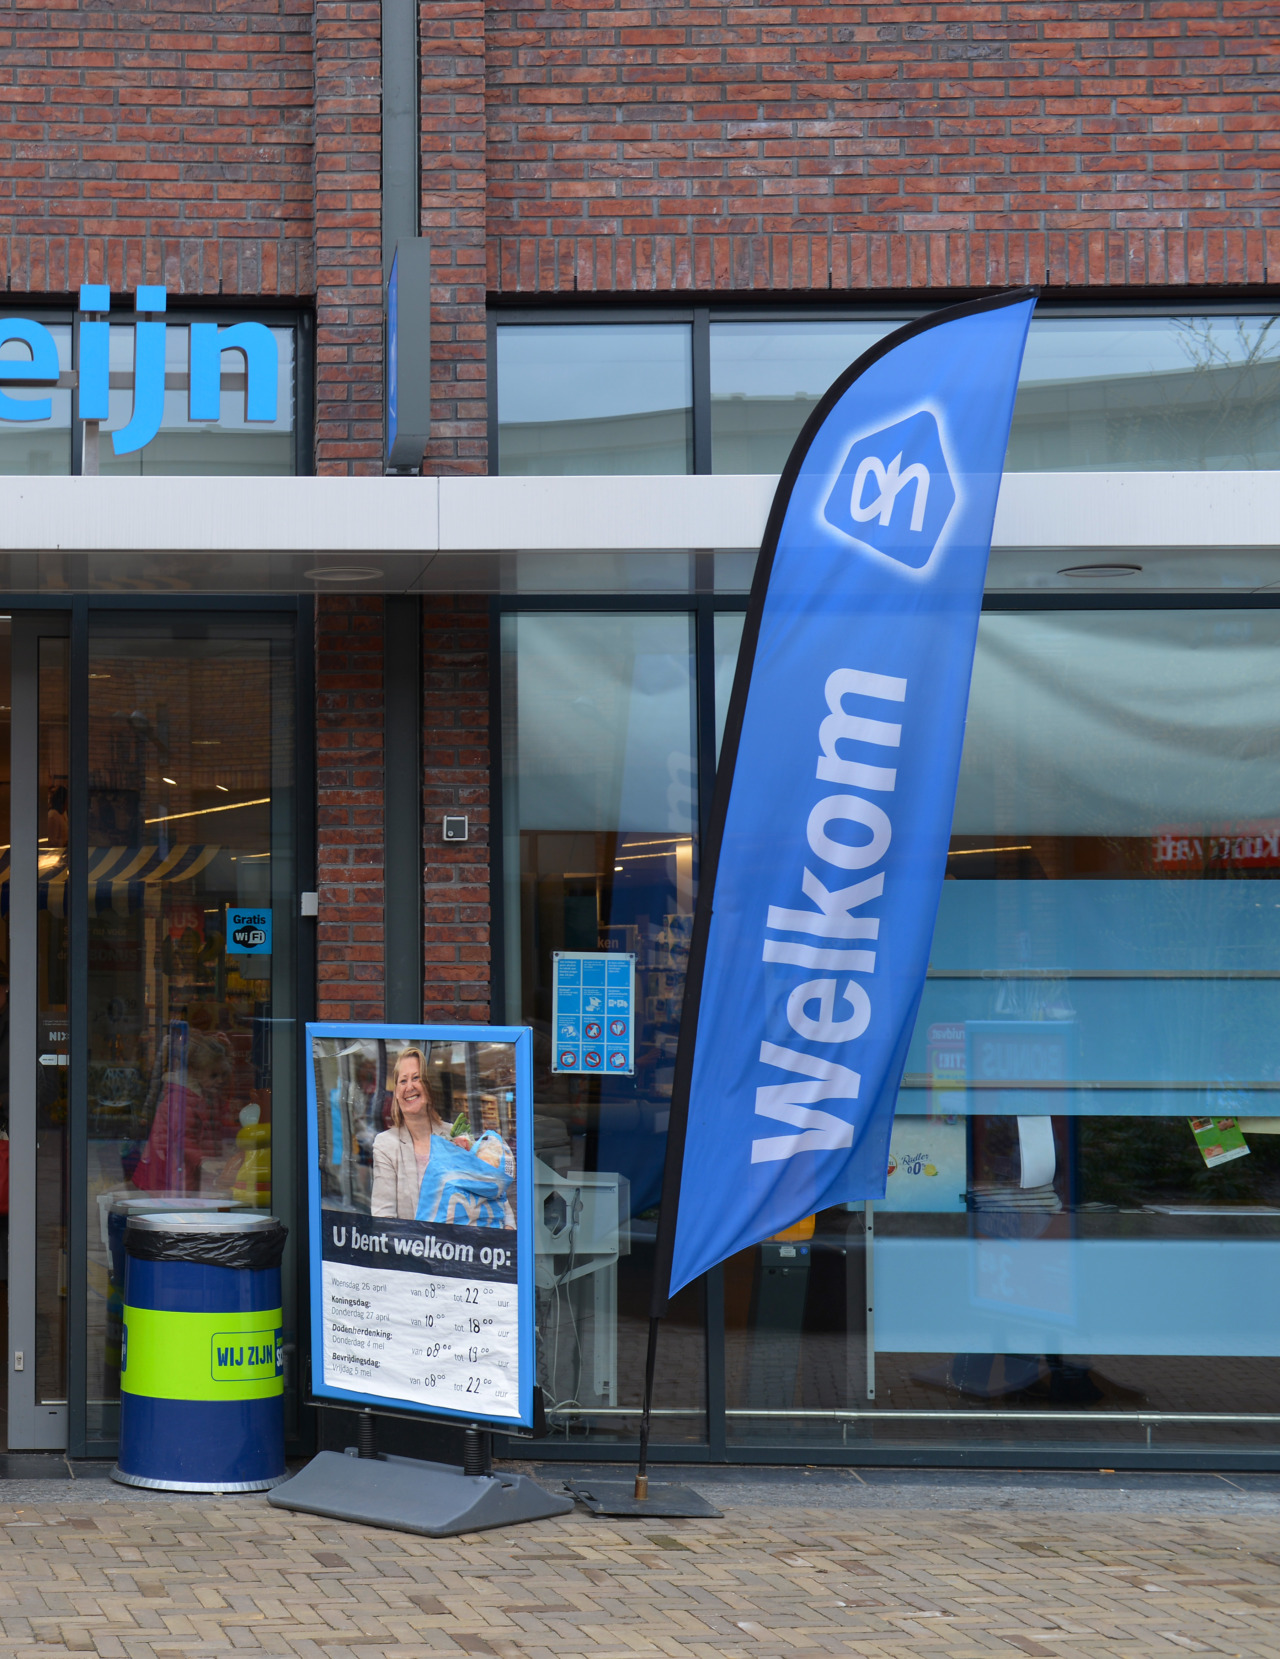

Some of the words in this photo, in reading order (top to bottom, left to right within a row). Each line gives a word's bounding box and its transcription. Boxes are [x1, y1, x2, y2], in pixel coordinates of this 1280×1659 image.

[233, 914, 266, 925] Gratis
[750, 667, 908, 1164] Welkom
[597, 937, 619, 949] ken
[332, 1225, 346, 1247] U
[351, 1227, 389, 1254] bent
[393, 1235, 473, 1262] welkom
[479, 1246, 512, 1270] op:
[331, 1277, 360, 1292] Woensdag
[361, 1282, 371, 1291] 26
[372, 1283, 387, 1294] april
[410, 1288, 422, 1297] van
[453, 1293, 463, 1303] tot
[497, 1300, 510, 1308] uur
[331, 1295, 372, 1308] Koningsdag:
[331, 1306, 365, 1321] Donderdag
[365, 1311, 374, 1320] 27
[375, 1312, 390, 1322] april
[410, 1318, 422, 1326] van
[454, 1323, 464, 1332] tot
[497, 1329, 510, 1338] uur
[331, 1323, 393, 1340] Dodenherdenking:
[217, 1346, 244, 1367] WIJ
[248, 1344, 273, 1366] ZIJN
[331, 1335, 365, 1349] Donderdag
[366, 1339, 371, 1347] 4
[372, 1342, 385, 1350] mei
[411, 1347, 423, 1356] van
[454, 1353, 464, 1361] tot
[497, 1360, 510, 1368] uur
[331, 1352, 381, 1368] Bevrijdingsdag:
[332, 1363, 354, 1377] Vrijdag
[354, 1366, 359, 1375] 5
[360, 1368, 372, 1378] mei
[409, 1377, 421, 1385] van
[453, 1383, 463, 1392] tot
[494, 1389, 508, 1398] uur
